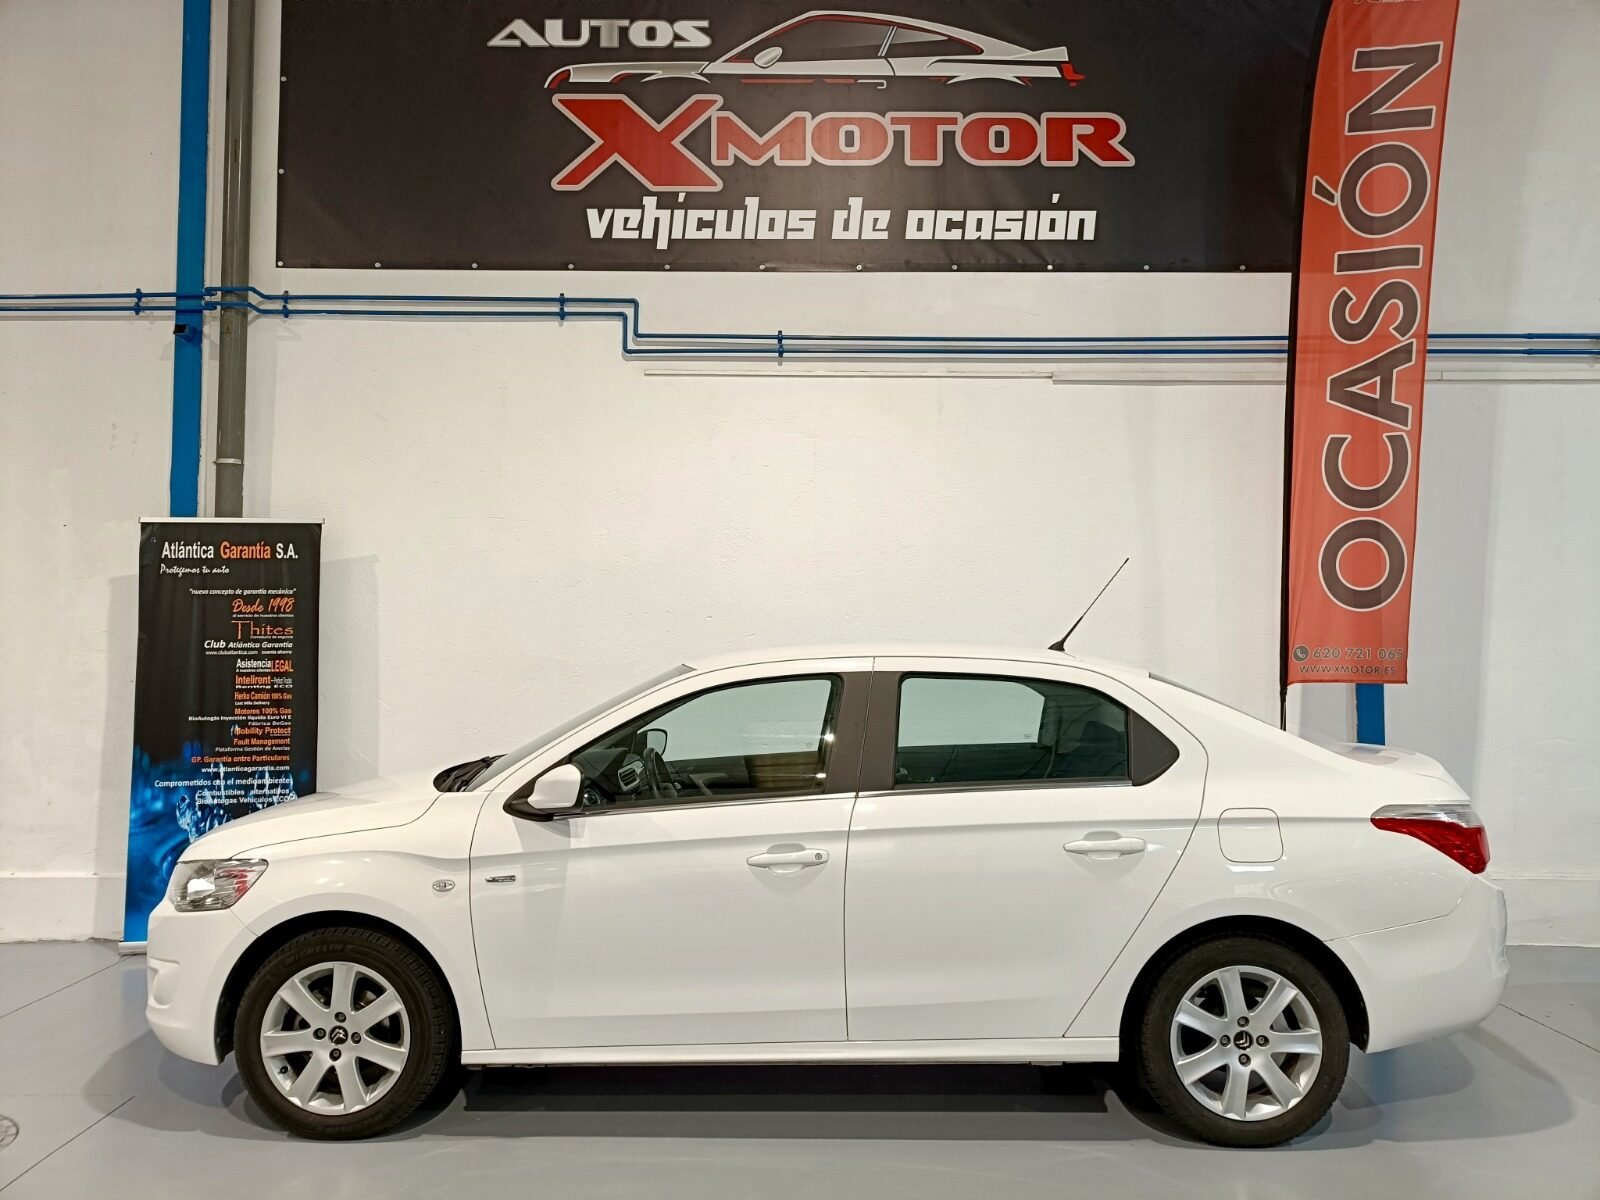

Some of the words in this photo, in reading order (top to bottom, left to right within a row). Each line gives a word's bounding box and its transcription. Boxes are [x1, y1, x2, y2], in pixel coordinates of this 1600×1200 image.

[486, 19, 712, 48] AUTOS
[586, 192, 817, 250] vehículos
[831, 197, 892, 240] de
[905, 193, 1097, 241] ocasión
[1312, 41, 1442, 612] OCASIÓN
[161, 541, 214, 559] Atlántica
[220, 541, 271, 559] Garantía
[275, 543, 299, 559] S.A.
[160, 563, 200, 578] Protegemos
[202, 565, 210, 573] tu
[212, 565, 230, 574] auto
[209, 588, 234, 596] concepto
[243, 588, 266, 596] garantía
[232, 598, 264, 613] Desde
[268, 597, 295, 613] 1998
[204, 640, 226, 649] Club
[228, 641, 260, 649] Atlántica
[1312, 647, 1341, 660] 620
[1344, 647, 1371, 660] 721
[1377, 647, 1404, 660] 065
[235, 675, 271, 685] Intelirent
[265, 726, 291, 734] Protect
[251, 738, 290, 746] Management
[252, 754, 290, 762] Particulares
[154, 778, 211, 788] Comprometidos
[235, 777, 290, 785] medioambiente
[197, 789, 245, 797] Combustibles
[250, 788, 289, 796] alternativos
